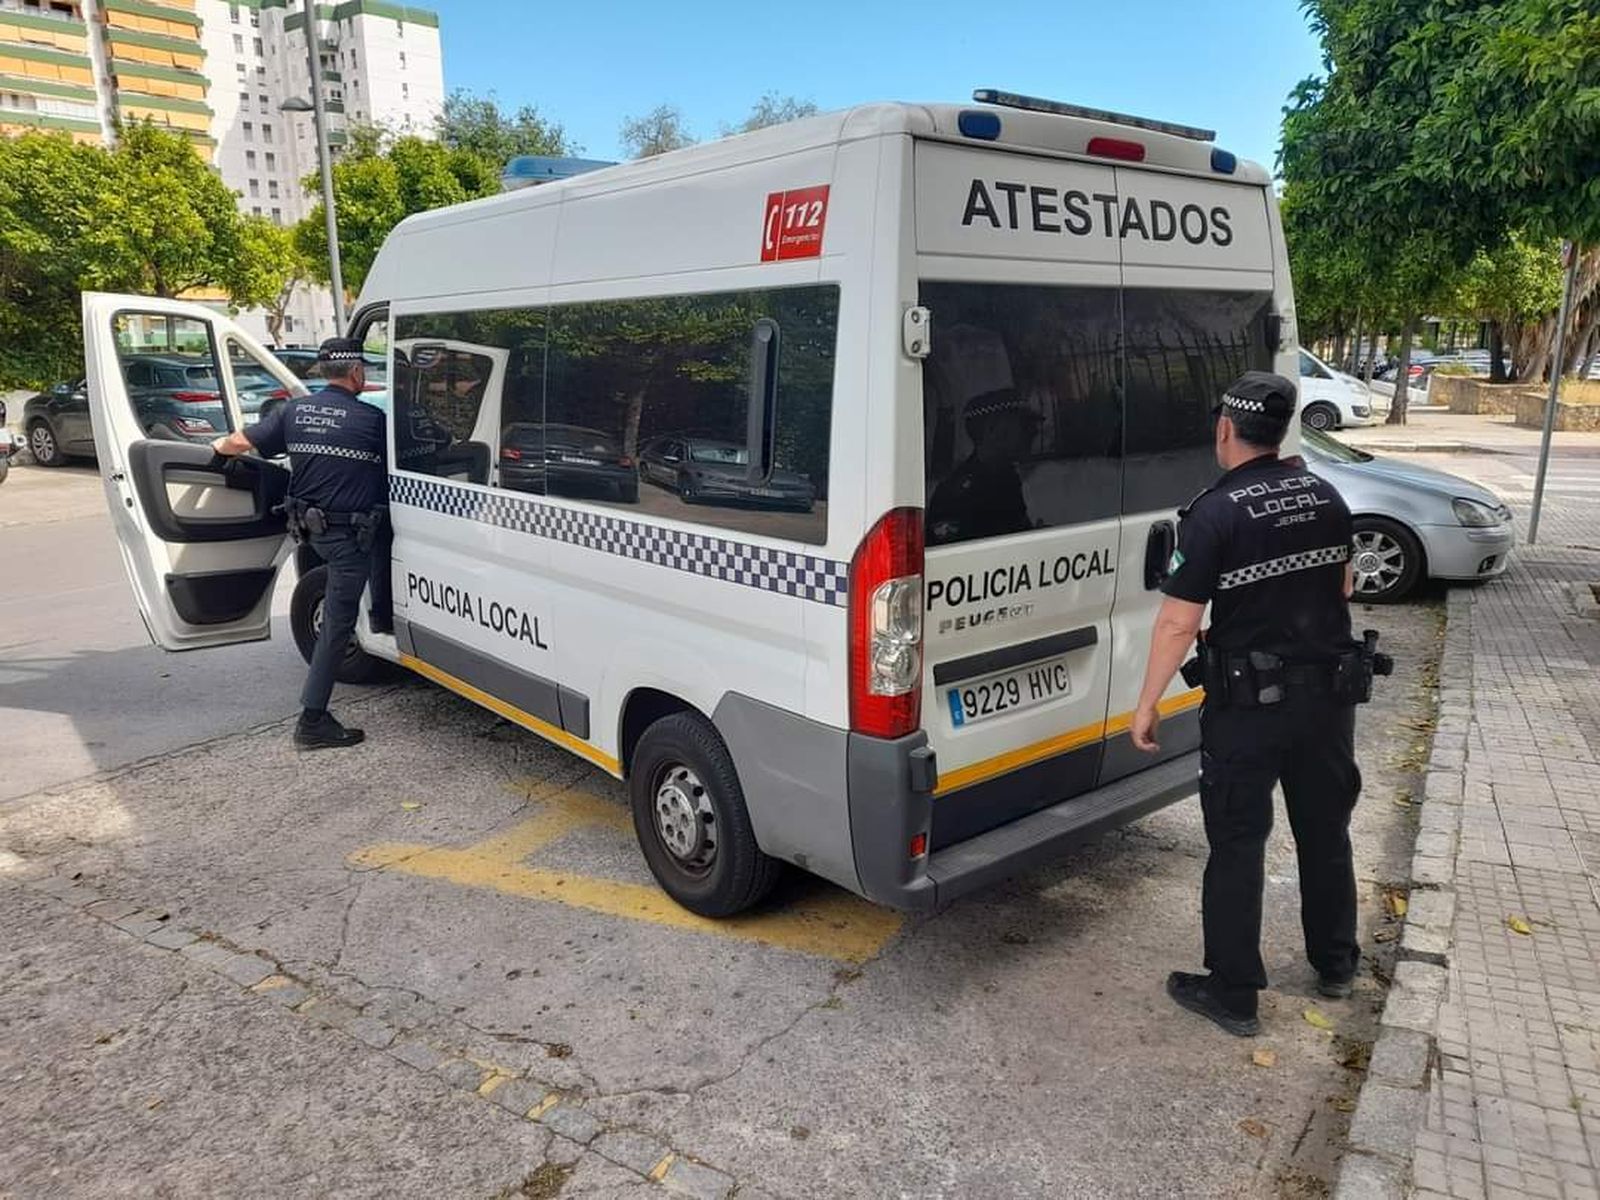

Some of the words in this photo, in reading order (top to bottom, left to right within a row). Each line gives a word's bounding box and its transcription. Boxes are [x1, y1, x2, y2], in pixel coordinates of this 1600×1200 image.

[785, 200, 823, 229] 112
[961, 178, 1233, 246] ATESTADOS
[295, 404, 347, 418] POLICIA
[295, 415, 342, 428] LOCAL
[1229, 476, 1320, 503] POLICIA
[1247, 492, 1331, 519] LOCAL
[1273, 511, 1317, 527] JEREZ
[926, 563, 1032, 612] POLICIA
[1038, 548, 1115, 588] LOCAL
[408, 572, 475, 622] POLICIA
[478, 596, 548, 650] LOCAL
[963, 677, 1021, 718] 9229
[1028, 664, 1067, 700] HVC
